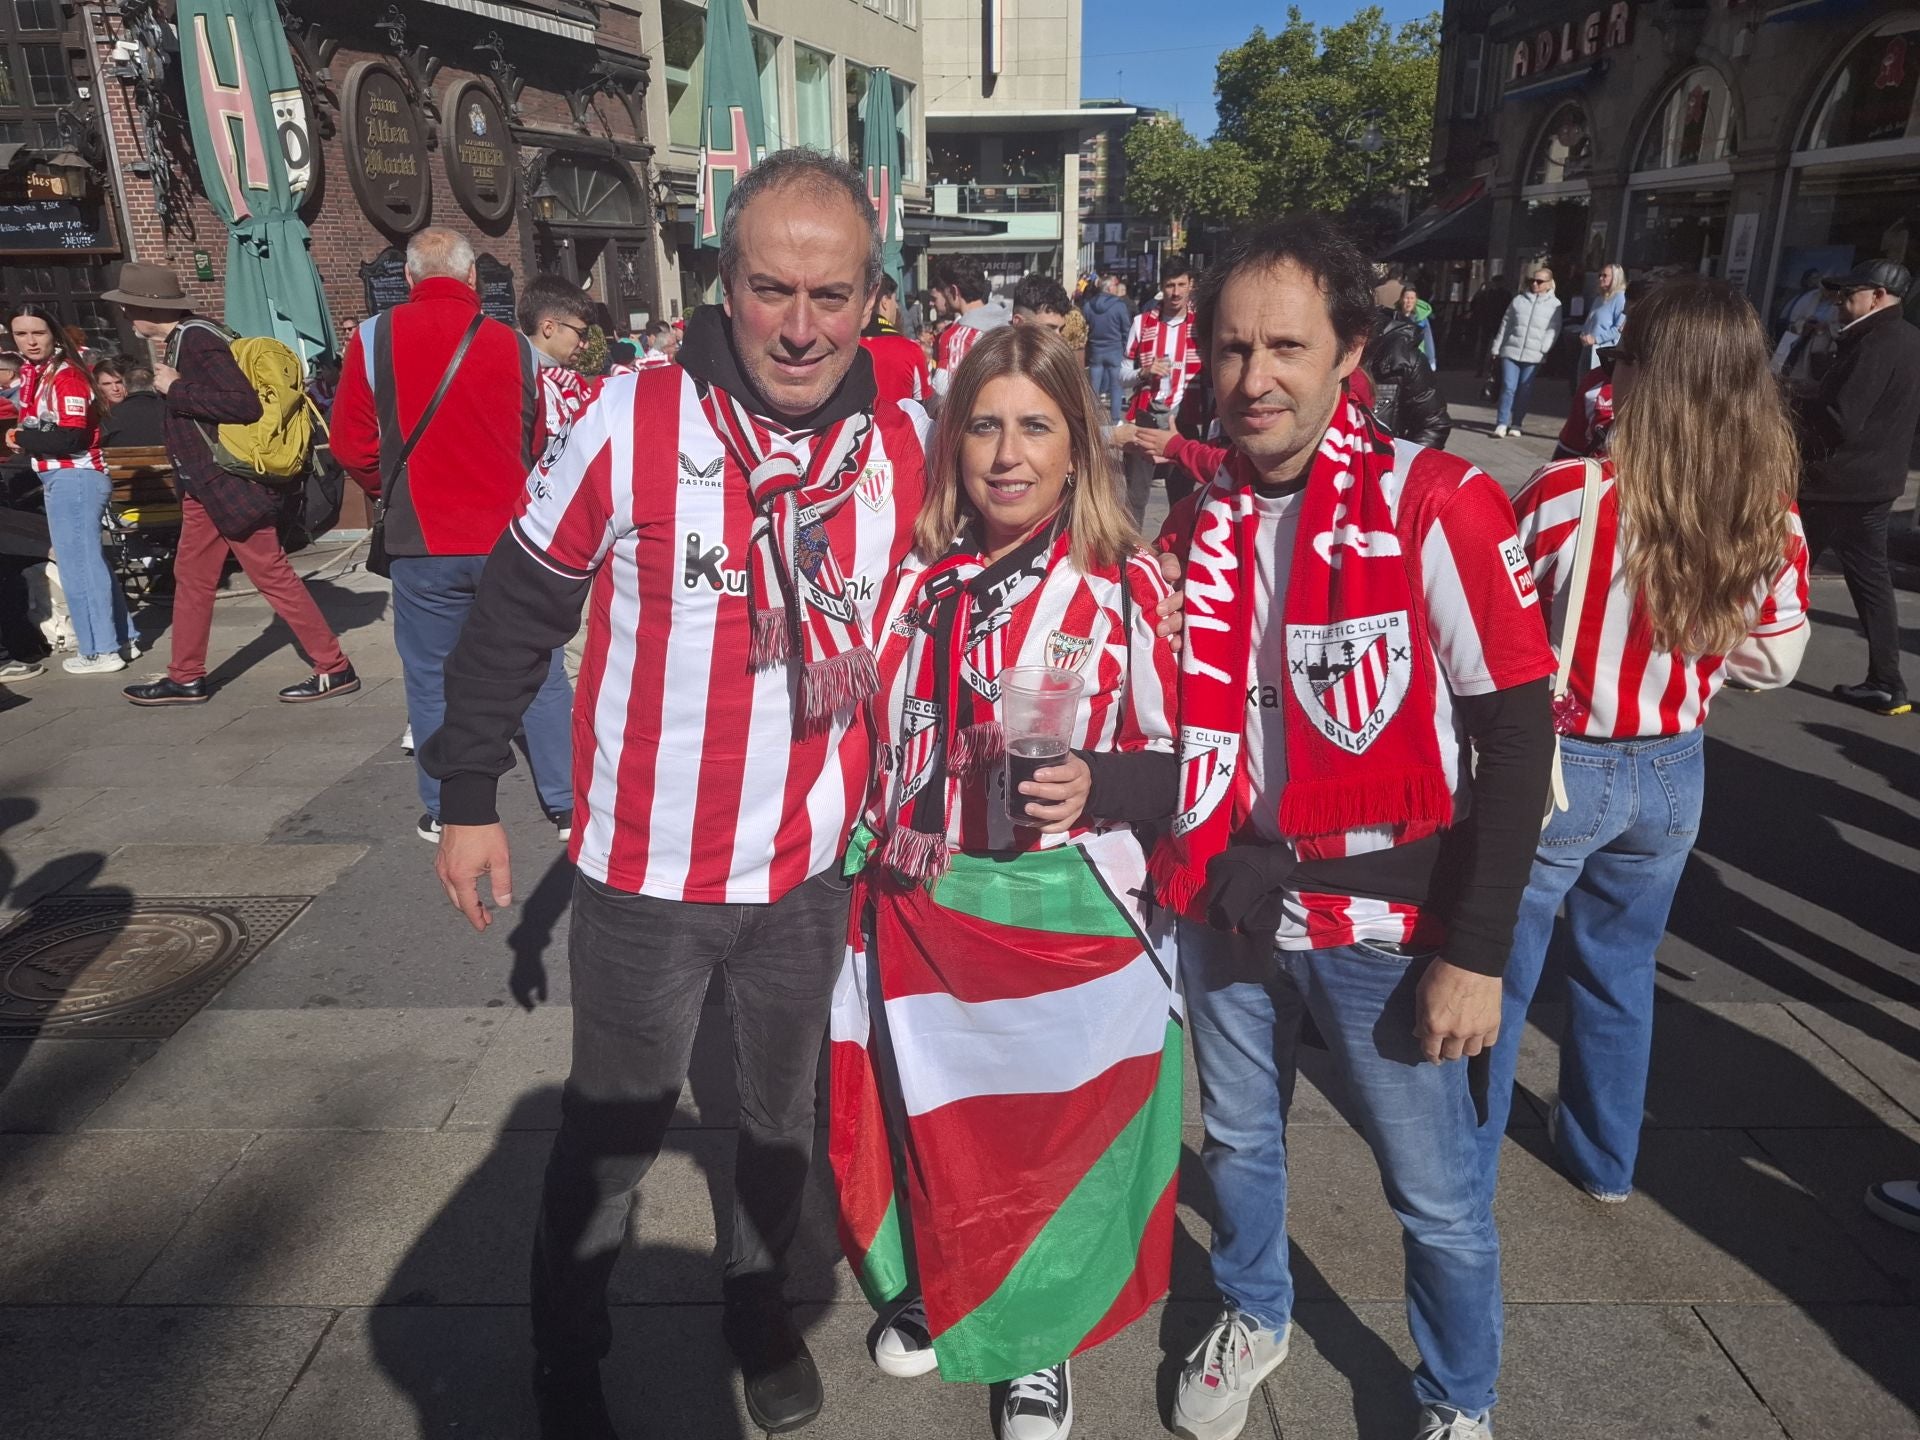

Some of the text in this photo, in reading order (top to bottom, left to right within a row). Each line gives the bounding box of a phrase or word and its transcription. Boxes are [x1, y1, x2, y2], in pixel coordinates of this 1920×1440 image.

[1510, 0, 1629, 79] ADLER
[365, 116, 410, 147] Alten
[364, 147, 417, 179] Markt
[981, 262, 1022, 271] AKERS
[679, 477, 722, 488] CASTORE
[809, 587, 851, 619] BILB
[1293, 616, 1400, 640] ATHLETIC CLUB
[970, 672, 1001, 699] BILB
[1195, 732, 1232, 746] CLUB
[1324, 709, 1385, 751] BILBAO
[1173, 811, 1198, 835] BAO
